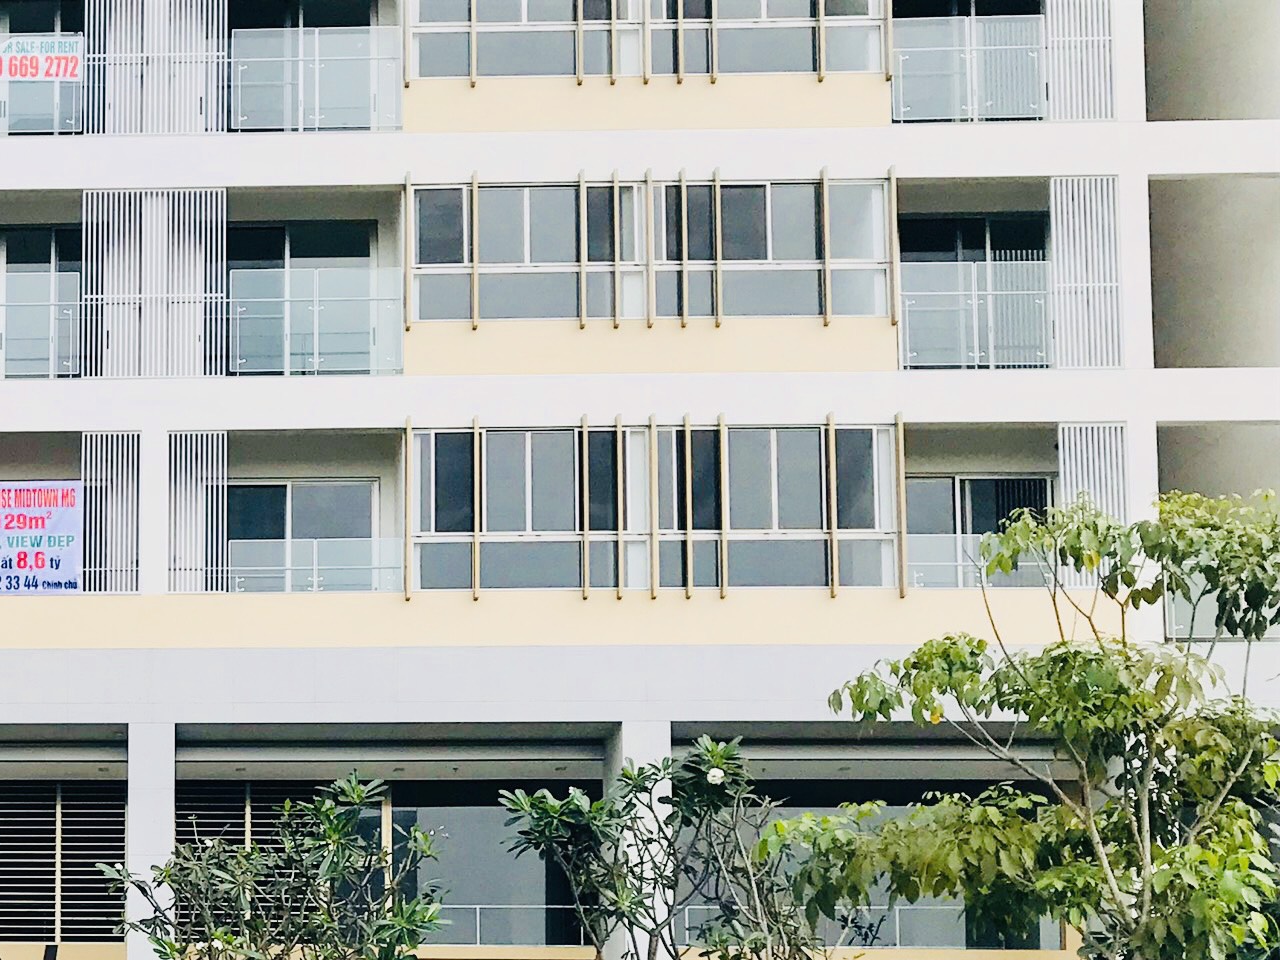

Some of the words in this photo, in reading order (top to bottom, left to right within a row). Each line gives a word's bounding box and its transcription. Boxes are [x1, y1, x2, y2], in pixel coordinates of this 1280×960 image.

[57, 40, 80, 53] RENT
[8, 54, 39, 77] 669
[44, 54, 79, 77] 2772
[14, 488, 59, 508] MIDTOWN
[61, 488, 76, 508] M6
[6, 535, 43, 548] VIEW
[47, 535, 75, 551] ĐẸP
[16, 551, 46, 572] 8,6
[5, 574, 20, 590] 33
[23, 575, 39, 590] 44
